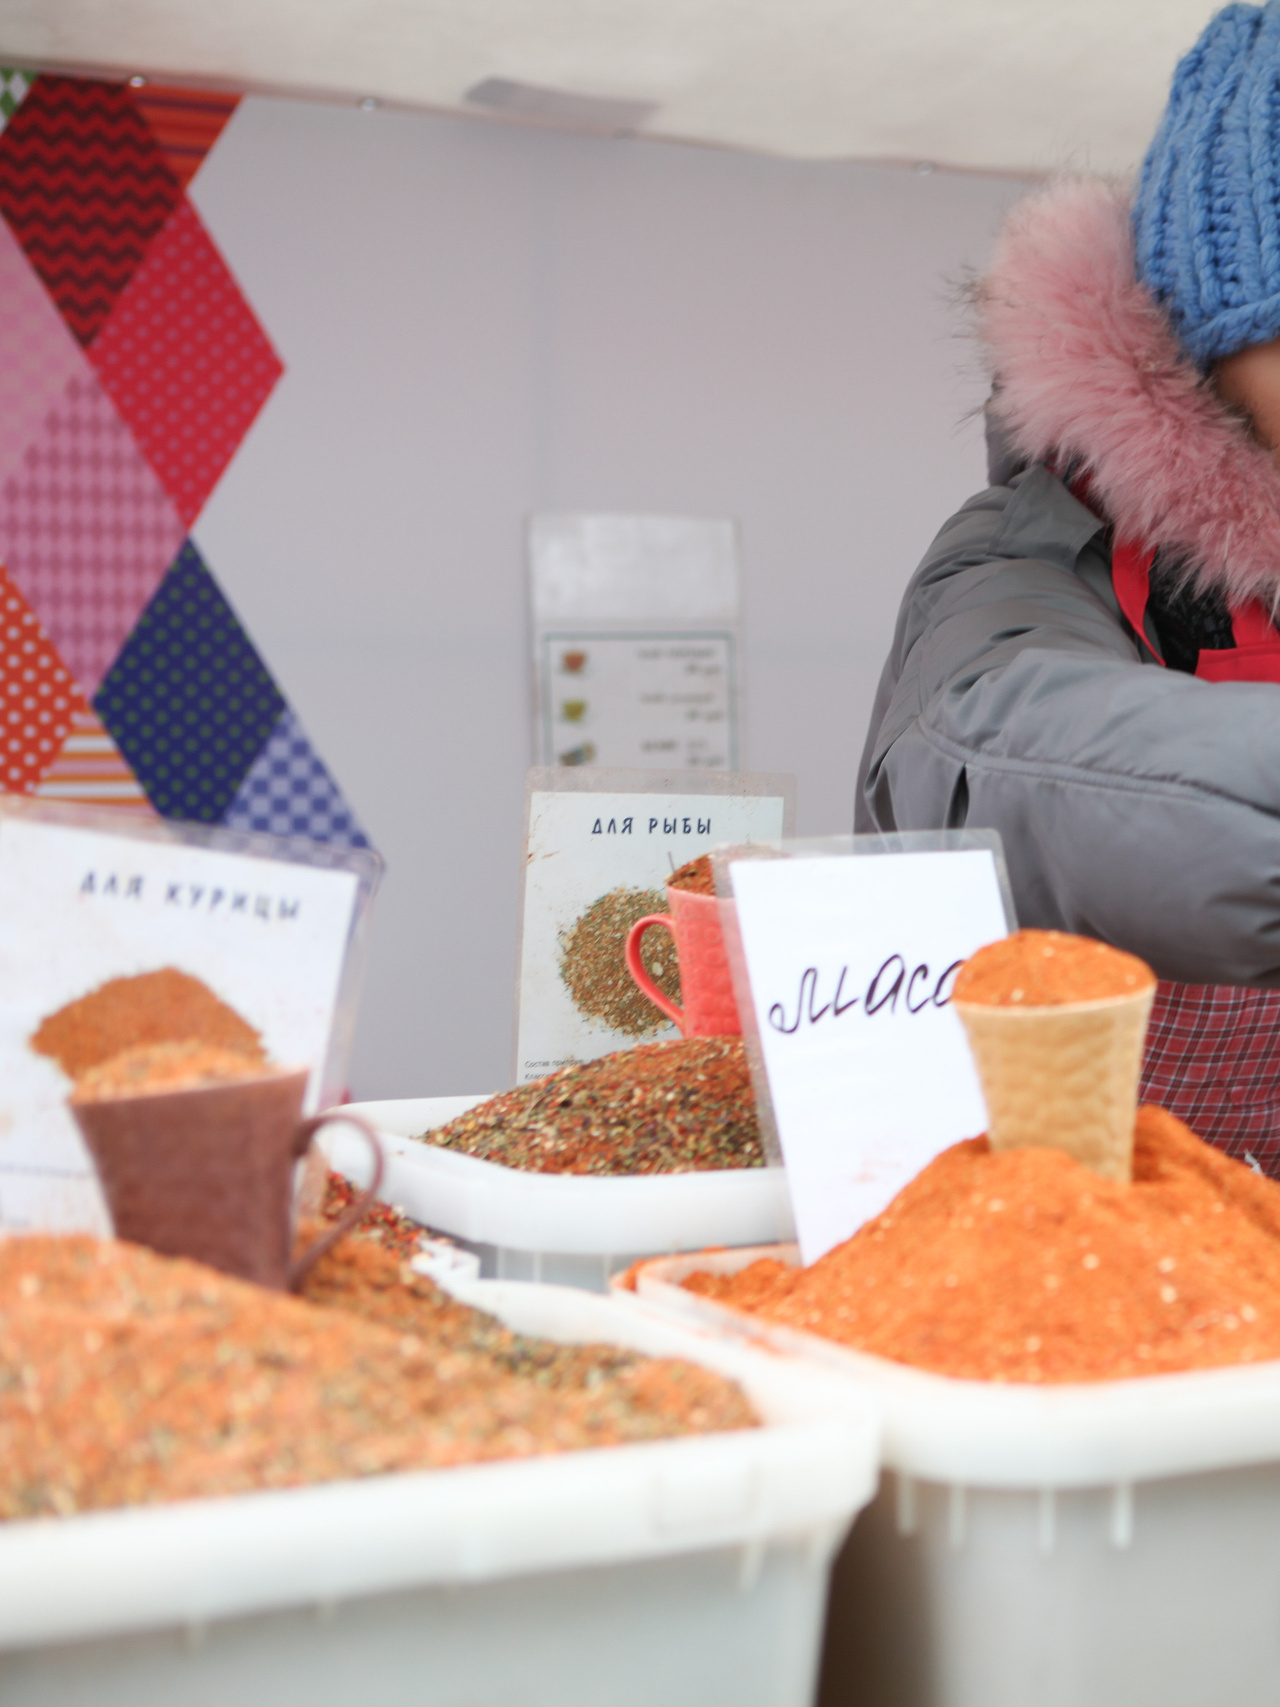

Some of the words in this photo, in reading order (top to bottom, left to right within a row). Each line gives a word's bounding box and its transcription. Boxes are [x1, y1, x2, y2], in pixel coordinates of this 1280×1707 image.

[591, 817, 634, 835] ДЛЯ
[648, 817, 711, 835] РЫБЫ
[80, 870, 143, 898] ДЛЯ
[164, 883, 301, 923] КУРИЦЫ
